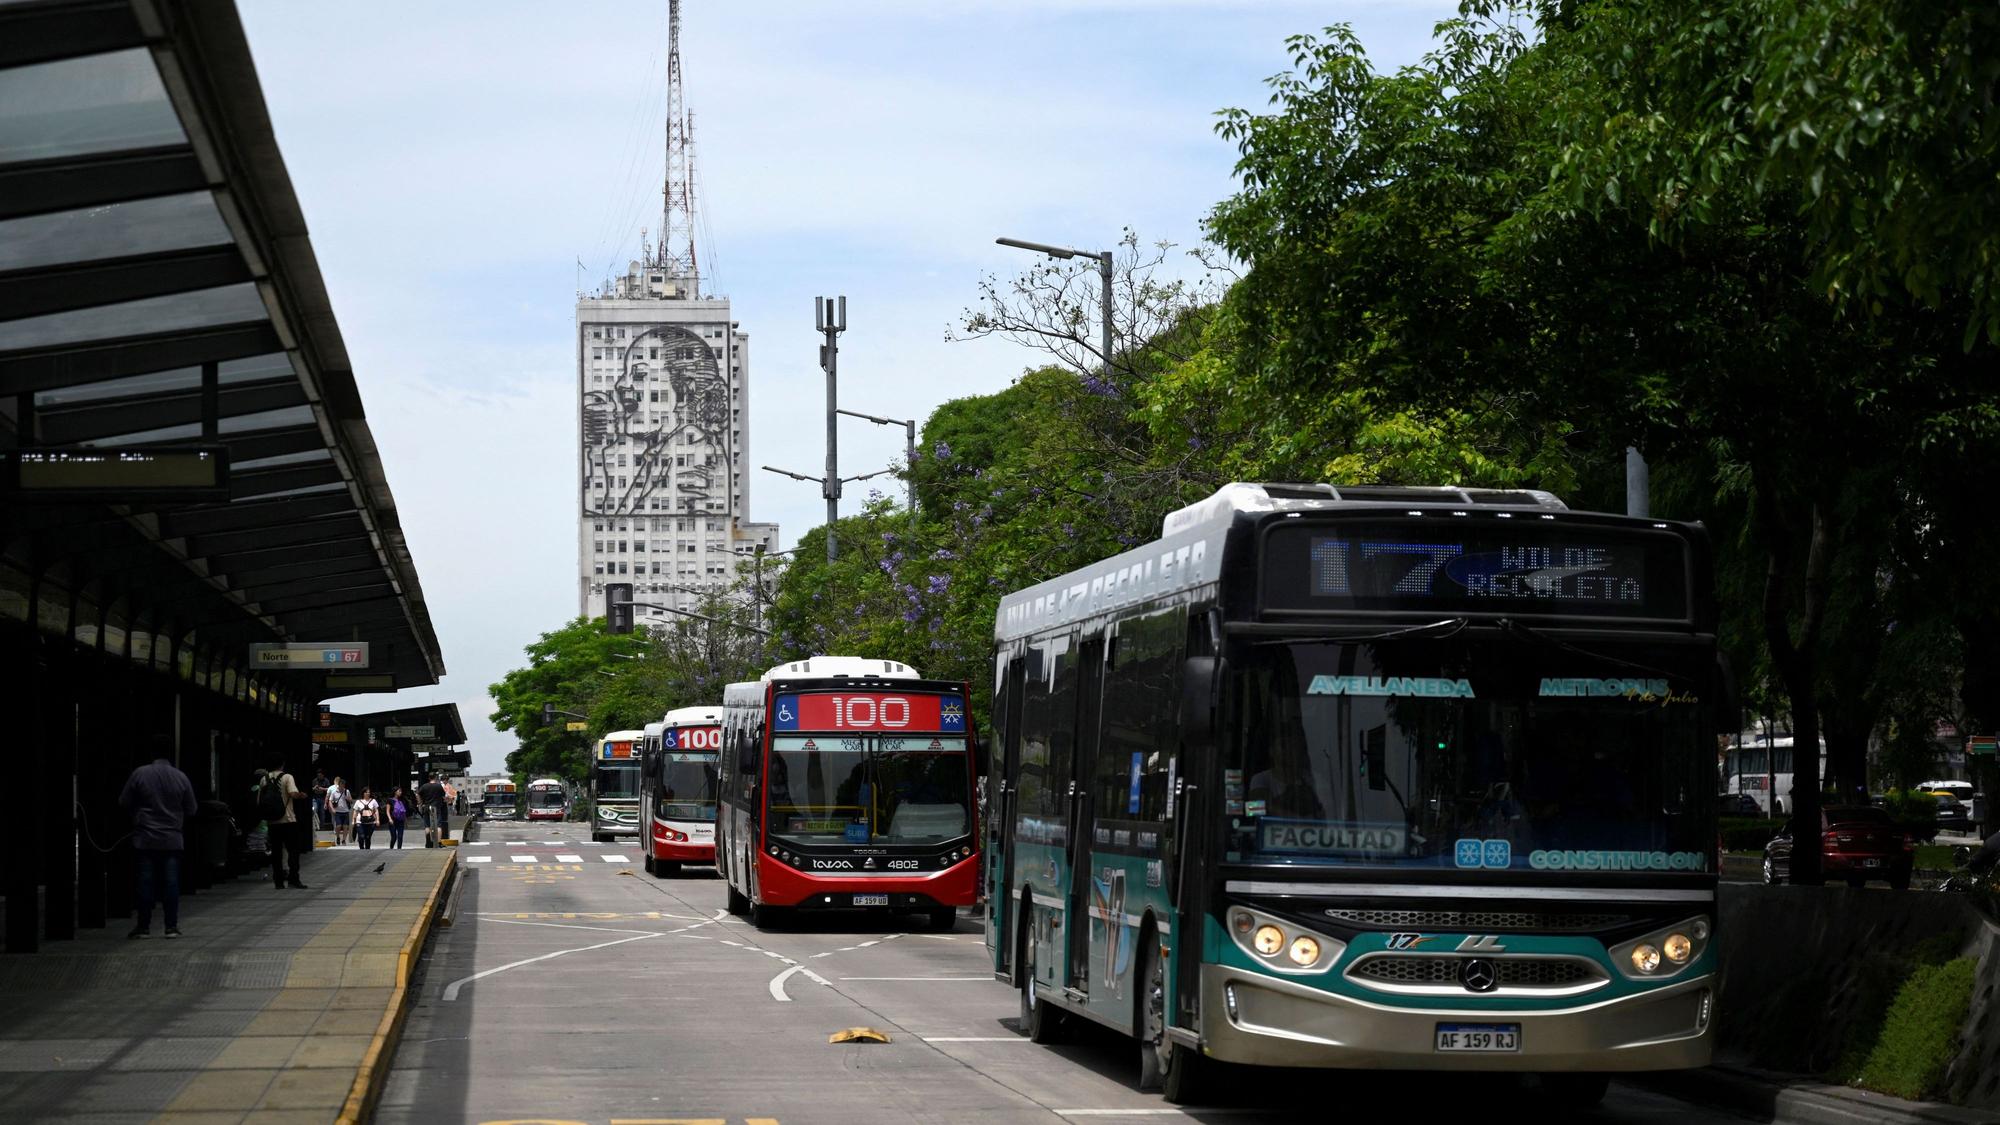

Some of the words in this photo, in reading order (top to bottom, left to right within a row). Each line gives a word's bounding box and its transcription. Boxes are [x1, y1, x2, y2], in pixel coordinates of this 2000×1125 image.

[1312, 542, 1464, 595] 17
[1501, 546, 1606, 571] WILDE
[1467, 573, 1640, 600] RECOLETA
[263, 652, 289, 662] Norte
[328, 652, 337, 662] 9
[344, 652, 358, 662] 67
[1306, 674, 1476, 698] AVELLANEDA
[832, 697, 910, 727] 100
[679, 729, 720, 749] 100
[1269, 826, 1397, 850] FACULTAD
[887, 860, 919, 869] 4802
[1529, 849, 1707, 872] CONSTITUCION
[865, 896, 877, 905] 159
[1386, 932, 1422, 950] 17
[1440, 1033, 1459, 1048] AF
[1464, 1033, 1491, 1048] 159
[1496, 1033, 1515, 1048] RJ
